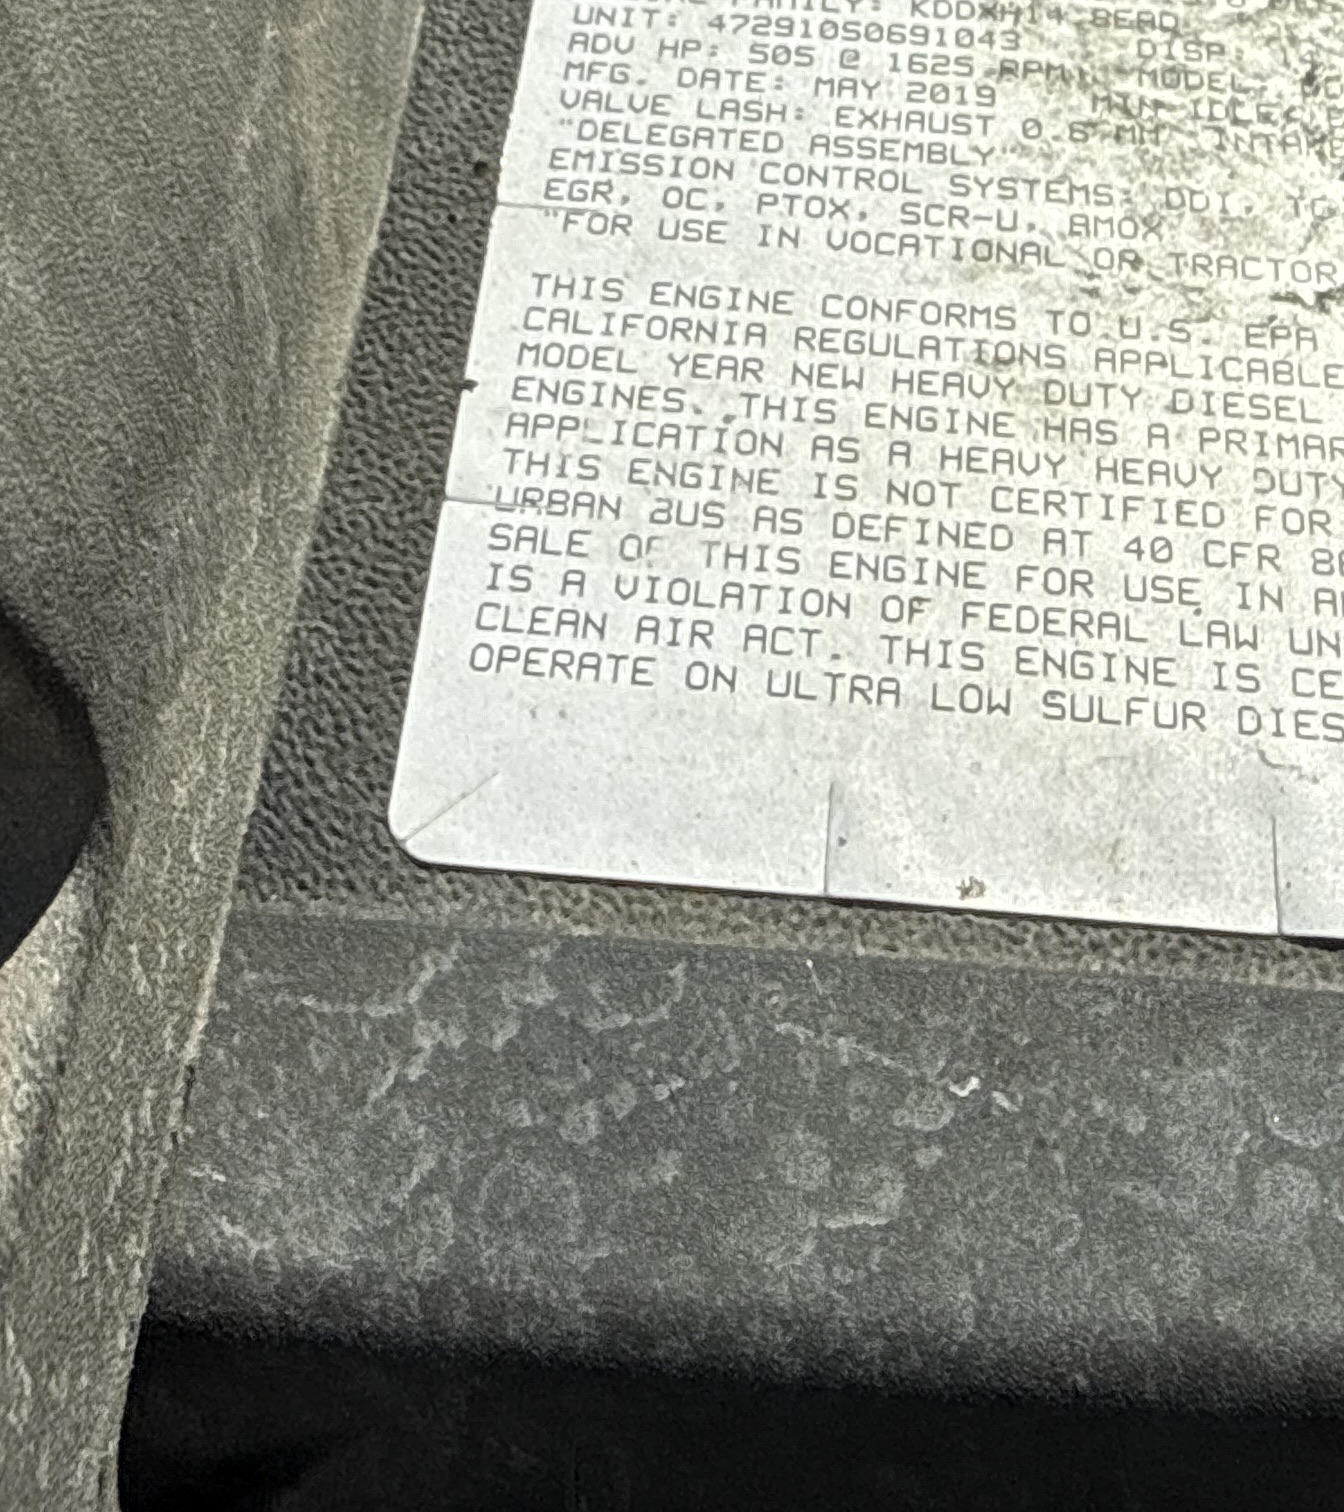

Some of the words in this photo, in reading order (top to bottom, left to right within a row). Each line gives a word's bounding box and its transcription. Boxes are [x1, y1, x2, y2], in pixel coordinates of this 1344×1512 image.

[568, 30, 635, 56] ADV
[657, 36, 721, 62] HP:
[748, 42, 815, 68] 505
[839, 47, 860, 71] @
[886, 51, 974, 78] 1625
[999, 58, 1066, 84] RPM
[572, 3, 679, 31] UNIT:
[706, 11, 1021, 53] 47291050691043
[557, 87, 672, 117] VALVE
[695, 96, 806, 126] LASH:
[834, 105, 996, 138] EXHAUST
[563, 58, 649, 86] MFG.
[676, 66, 786, 95] DATE:
[814, 74, 882, 101] MAY
[906, 80, 997, 109] 2019
[548, 146, 735, 182] EMISSION
[759, 160, 923, 195] CONTROL
[949, 173, 1133, 209] SYSTEMS:
[657, 215, 729, 245] USE
[755, 222, 801, 250] IN
[826, 227, 1066, 269] VOCATIONAL
[1094, 245, 1140, 274] OR
[521, 304, 767, 348] CALIFORNIA
[793, 324, 1066, 370] REGULATIONS
[527, 271, 625, 303] THIS
[649, 280, 795, 316] ENGINE
[821, 292, 1017, 332] CONFORMS
[1044, 308, 1091, 337] TO
[1119, 313, 1212, 346] U.S.
[1244, 322, 1318, 354] EPA
[510, 374, 706, 416] ENGINES.
[737, 391, 837, 426] THIS
[864, 400, 1015, 439] ENGINE
[1044, 413, 1118, 447] HAS
[1147, 421, 1170, 451] A
[516, 339, 640, 375] MODEL
[665, 350, 764, 384] YEAR
[790, 359, 864, 392] NEW
[891, 366, 1016, 403] HEAVY
[1044, 377, 1143, 412] DUTY
[1171, 387, 1323, 426] DIESEL
[498, 446, 601, 482] THIS
[627, 456, 781, 496] ENGINE
[810, 470, 858, 502] IS
[886, 476, 962, 510] NOT
[991, 484, 1225, 530] CERTIFIED
[1254, 504, 1332, 538] FOR
[505, 410, 784, 459] APPLICATION
[811, 433, 861, 465] AS
[888, 439, 912, 469] A
[940, 443, 1067, 481] HEAVY
[1096, 454, 1224, 493] HEAVY
[487, 522, 592, 559] SALE
[697, 538, 801, 576] THIS
[829, 548, 987, 591] ENGINE
[1016, 563, 1094, 599] FOR
[1124, 571, 1202, 608] USE
[1234, 580, 1284, 614] IN
[493, 484, 623, 522] URBAN
[753, 504, 804, 536] AS
[832, 510, 1014, 552] DEFINED
[1043, 526, 1093, 559] AT
[1123, 532, 1174, 565] 40
[1203, 538, 1281, 573] CFR
[474, 600, 608, 642] CLEAN
[634, 613, 715, 650] AIR
[742, 621, 844, 661] ACT.
[878, 632, 985, 673] THIS
[1015, 643, 1177, 688] ENGINE
[1210, 659, 1261, 695] IS
[483, 561, 534, 594] IS
[560, 567, 587, 599] A
[613, 572, 852, 620] VIOLATION
[880, 593, 932, 627] OF
[961, 599, 1149, 644] FEDERAL
[1179, 616, 1259, 653] LAW
[467, 641, 657, 688] OPERATE
[684, 659, 738, 694] ON
[766, 665, 901, 708] ULTRA
[931, 679, 1011, 717] LOW
[1042, 688, 1206, 733] SULFUR
